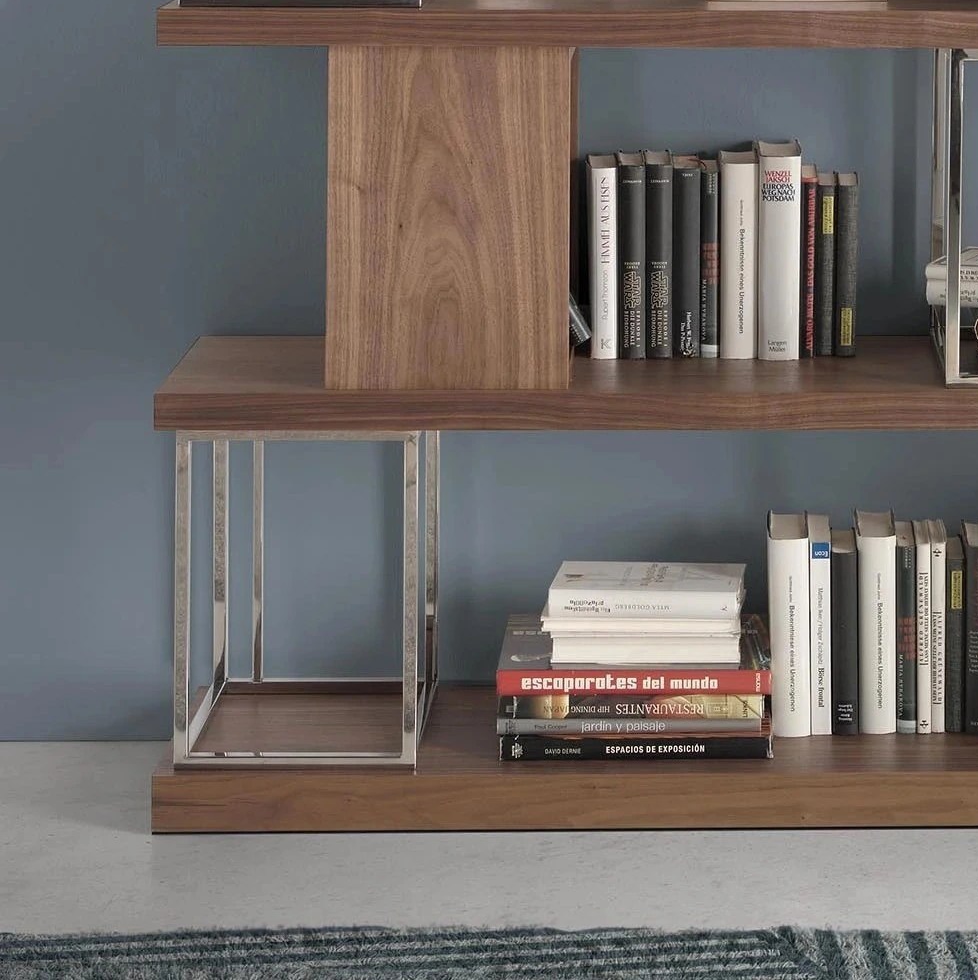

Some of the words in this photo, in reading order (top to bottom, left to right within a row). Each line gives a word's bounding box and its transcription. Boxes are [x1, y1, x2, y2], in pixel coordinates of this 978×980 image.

[623, 271, 634, 310] WARS
[632, 271, 642, 308] STAR
[650, 271, 661, 309] WARS
[658, 271, 669, 308] STAR
[737, 291, 745, 334] Unerzogenen
[521, 674, 637, 692] escaparates
[642, 676, 664, 690] del
[669, 676, 718, 690] mundo
[876, 666, 884, 709] Unerzogenen
[571, 705, 596, 713] DINING
[597, 705, 610, 713] HIP
[616, 703, 704, 716] RESTAURANTES
[615, 722, 623, 733] y
[626, 721, 666, 733] paisaje
[605, 745, 644, 754] ESPACIOS
[646, 745, 656, 753] DE
[658, 743, 705, 753] EXPOSICIÓN
